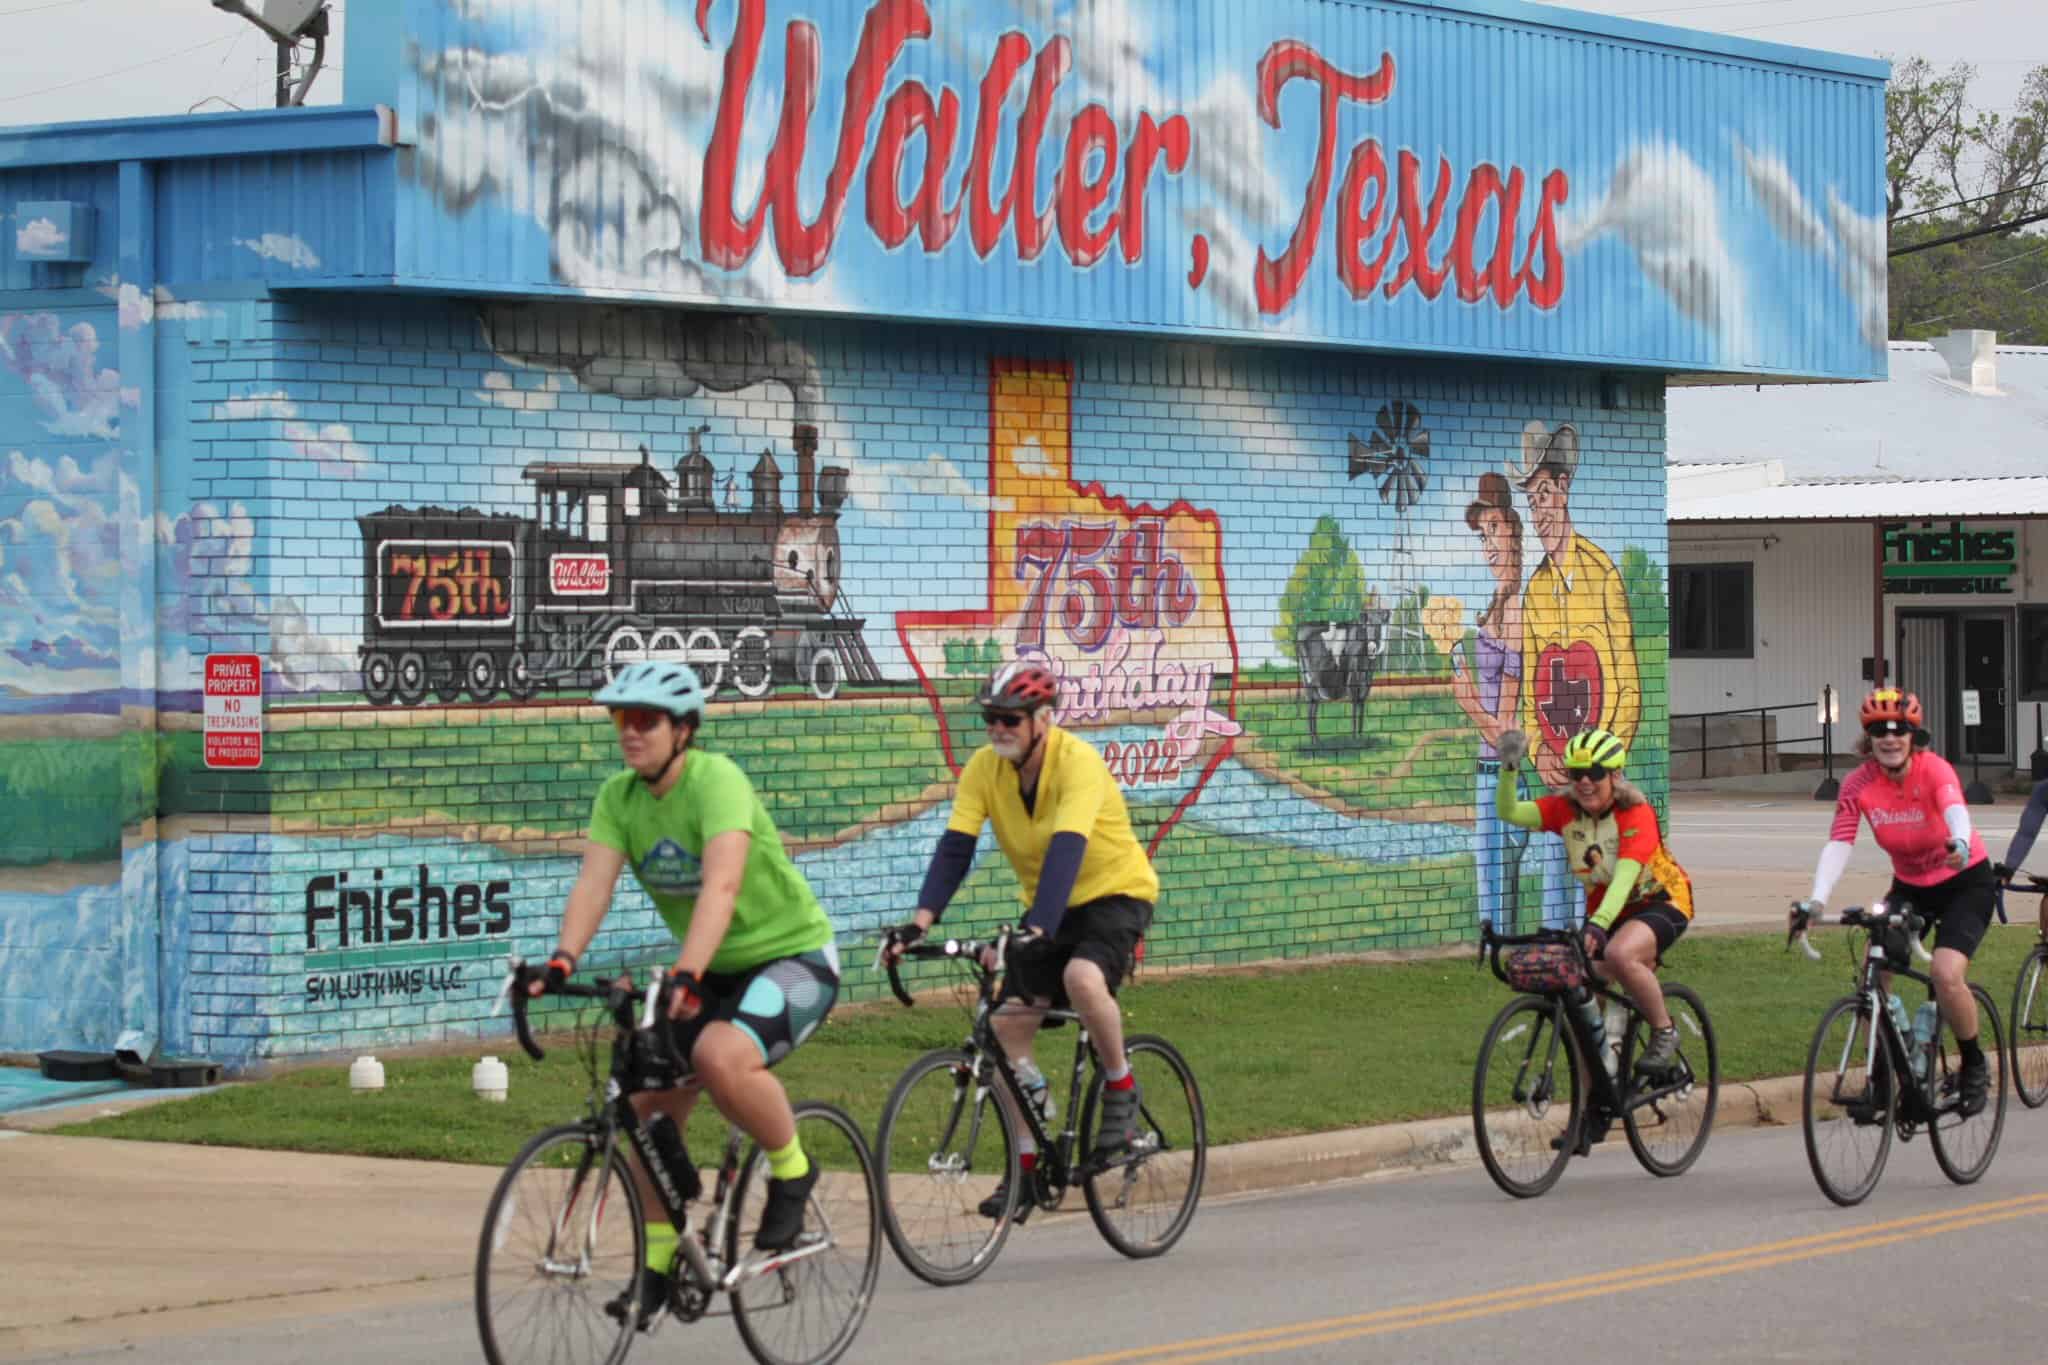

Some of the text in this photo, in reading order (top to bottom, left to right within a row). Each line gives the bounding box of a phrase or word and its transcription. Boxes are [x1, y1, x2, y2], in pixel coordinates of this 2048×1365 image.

[696, 0, 1568, 314] Waller, Texas
[390, 549, 509, 620] 75th
[555, 560, 614, 587] Waller
[1015, 517, 1198, 652] 75th
[207, 679, 257, 693] PROPERTY
[213, 663, 252, 677] PRIVATE
[207, 716, 259, 729] TRESPASSING
[224, 699, 241, 713] NO
[1104, 738, 1181, 786] 2022
[305, 864, 511, 949] Finishes
[305, 969, 423, 1003] SOLUTIONS
